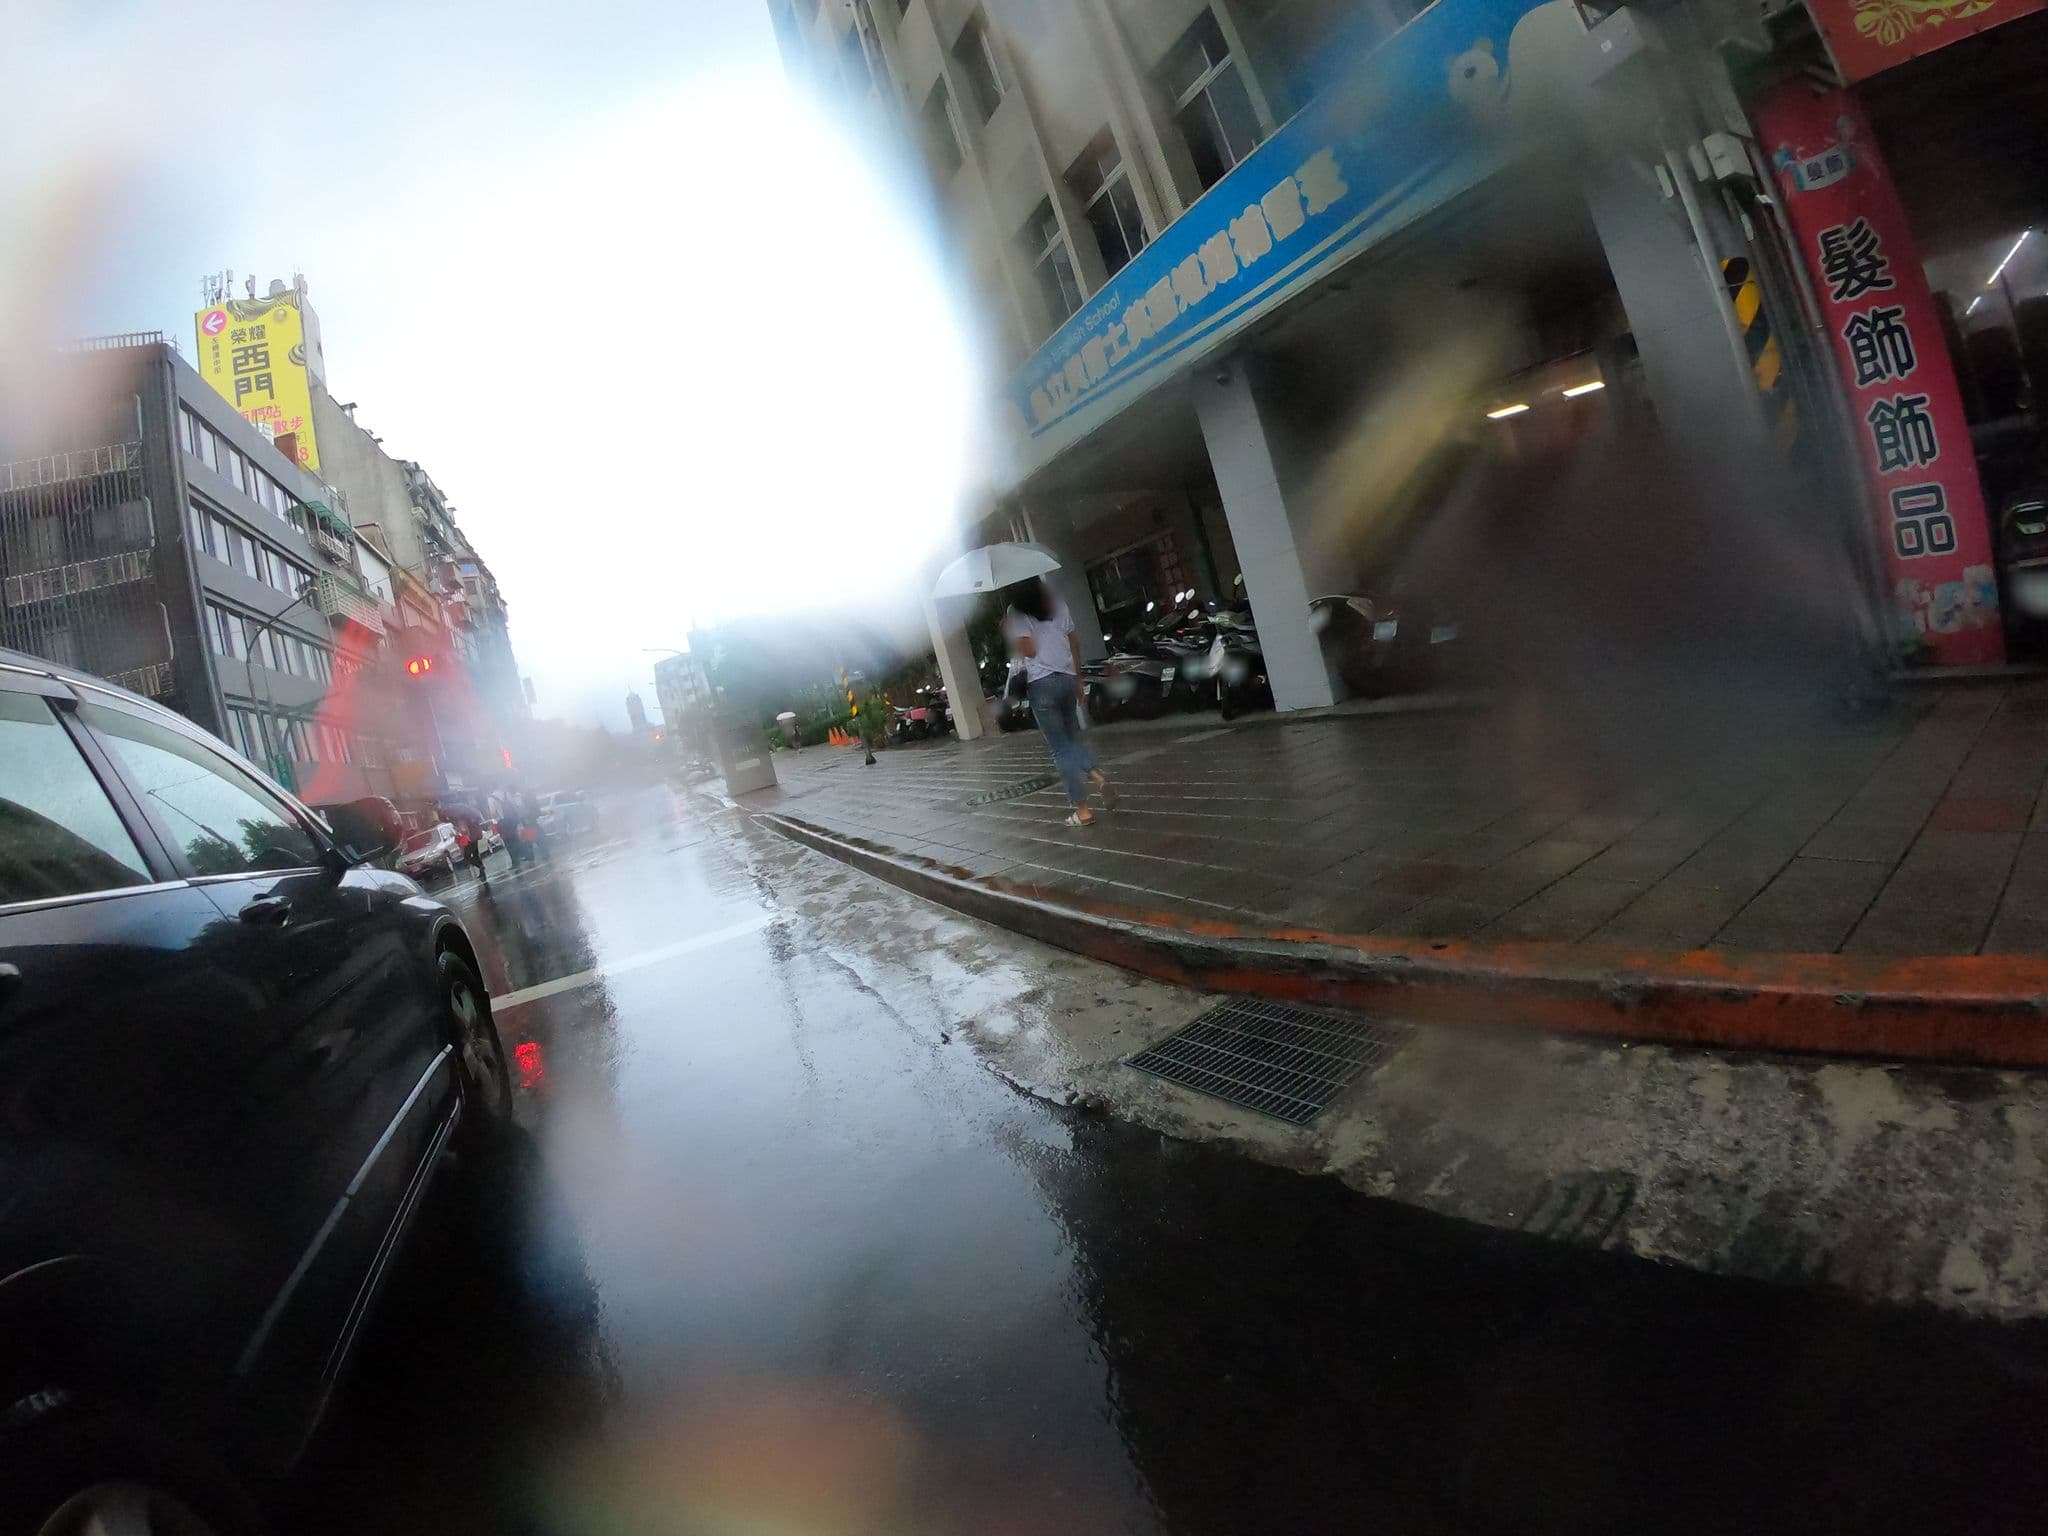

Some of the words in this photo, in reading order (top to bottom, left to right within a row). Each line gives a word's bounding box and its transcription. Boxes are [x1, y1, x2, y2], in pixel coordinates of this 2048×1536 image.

[230, 324, 266, 345] 榮耀
[1085, 288, 1121, 331] School
[231, 342, 275, 407] 西門
[1818, 217, 1957, 559] 髮飾飾品
